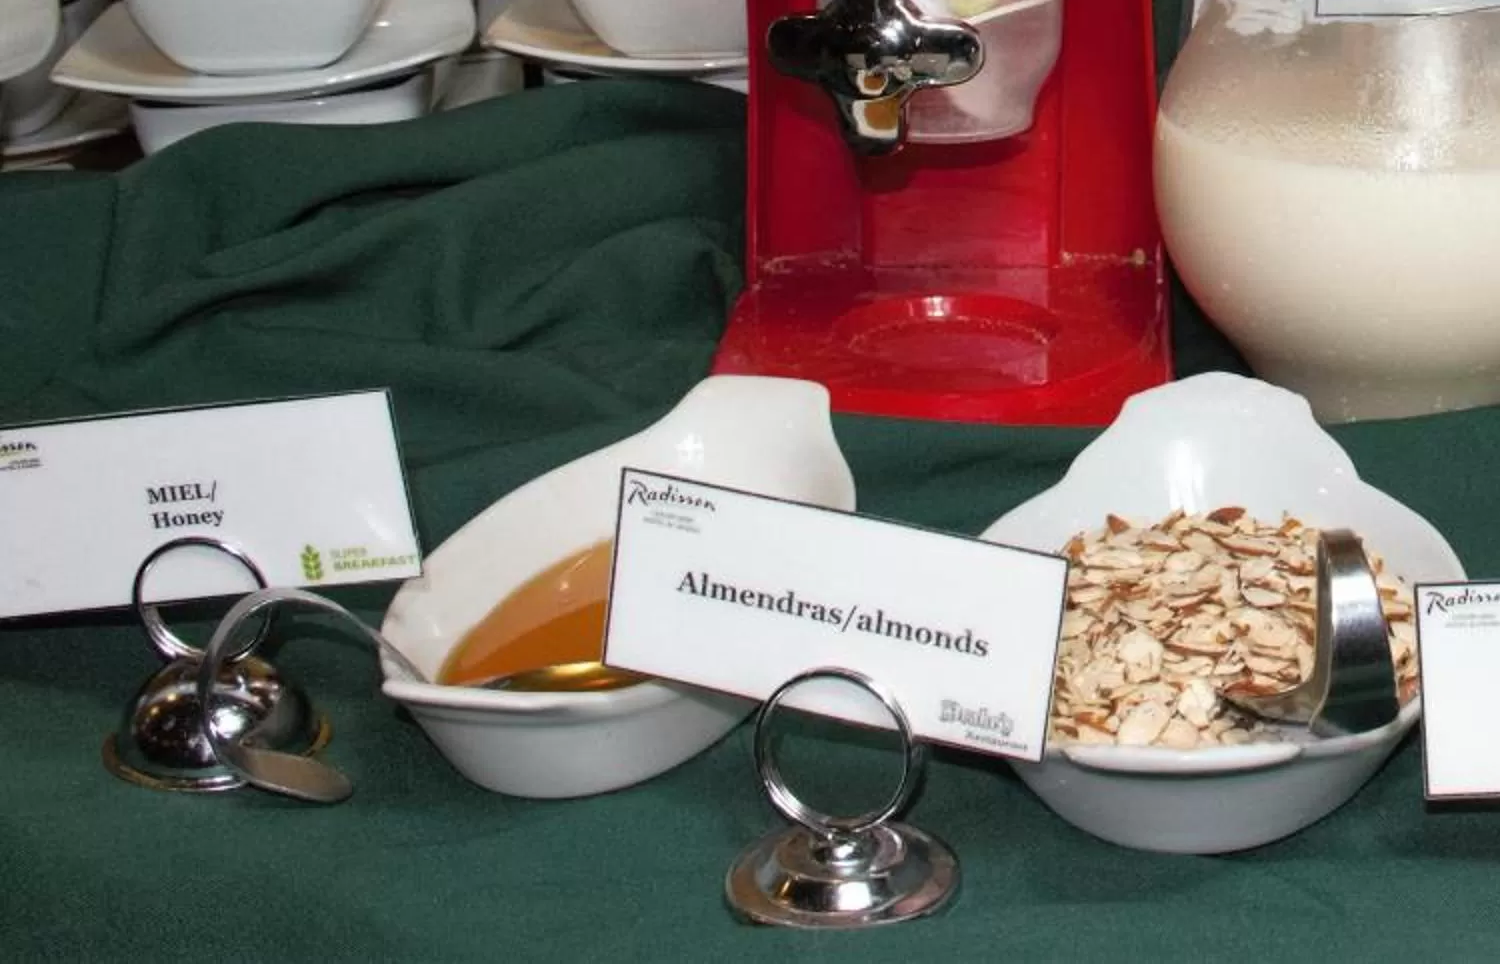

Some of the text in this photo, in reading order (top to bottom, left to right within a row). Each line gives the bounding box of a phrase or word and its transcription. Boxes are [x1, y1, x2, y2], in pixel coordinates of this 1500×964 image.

[147, 480, 217, 505] MIEL/
[627, 479, 716, 513] Radisson
[152, 509, 225, 529] Honey
[677, 570, 990, 658] Almendras/almonds
